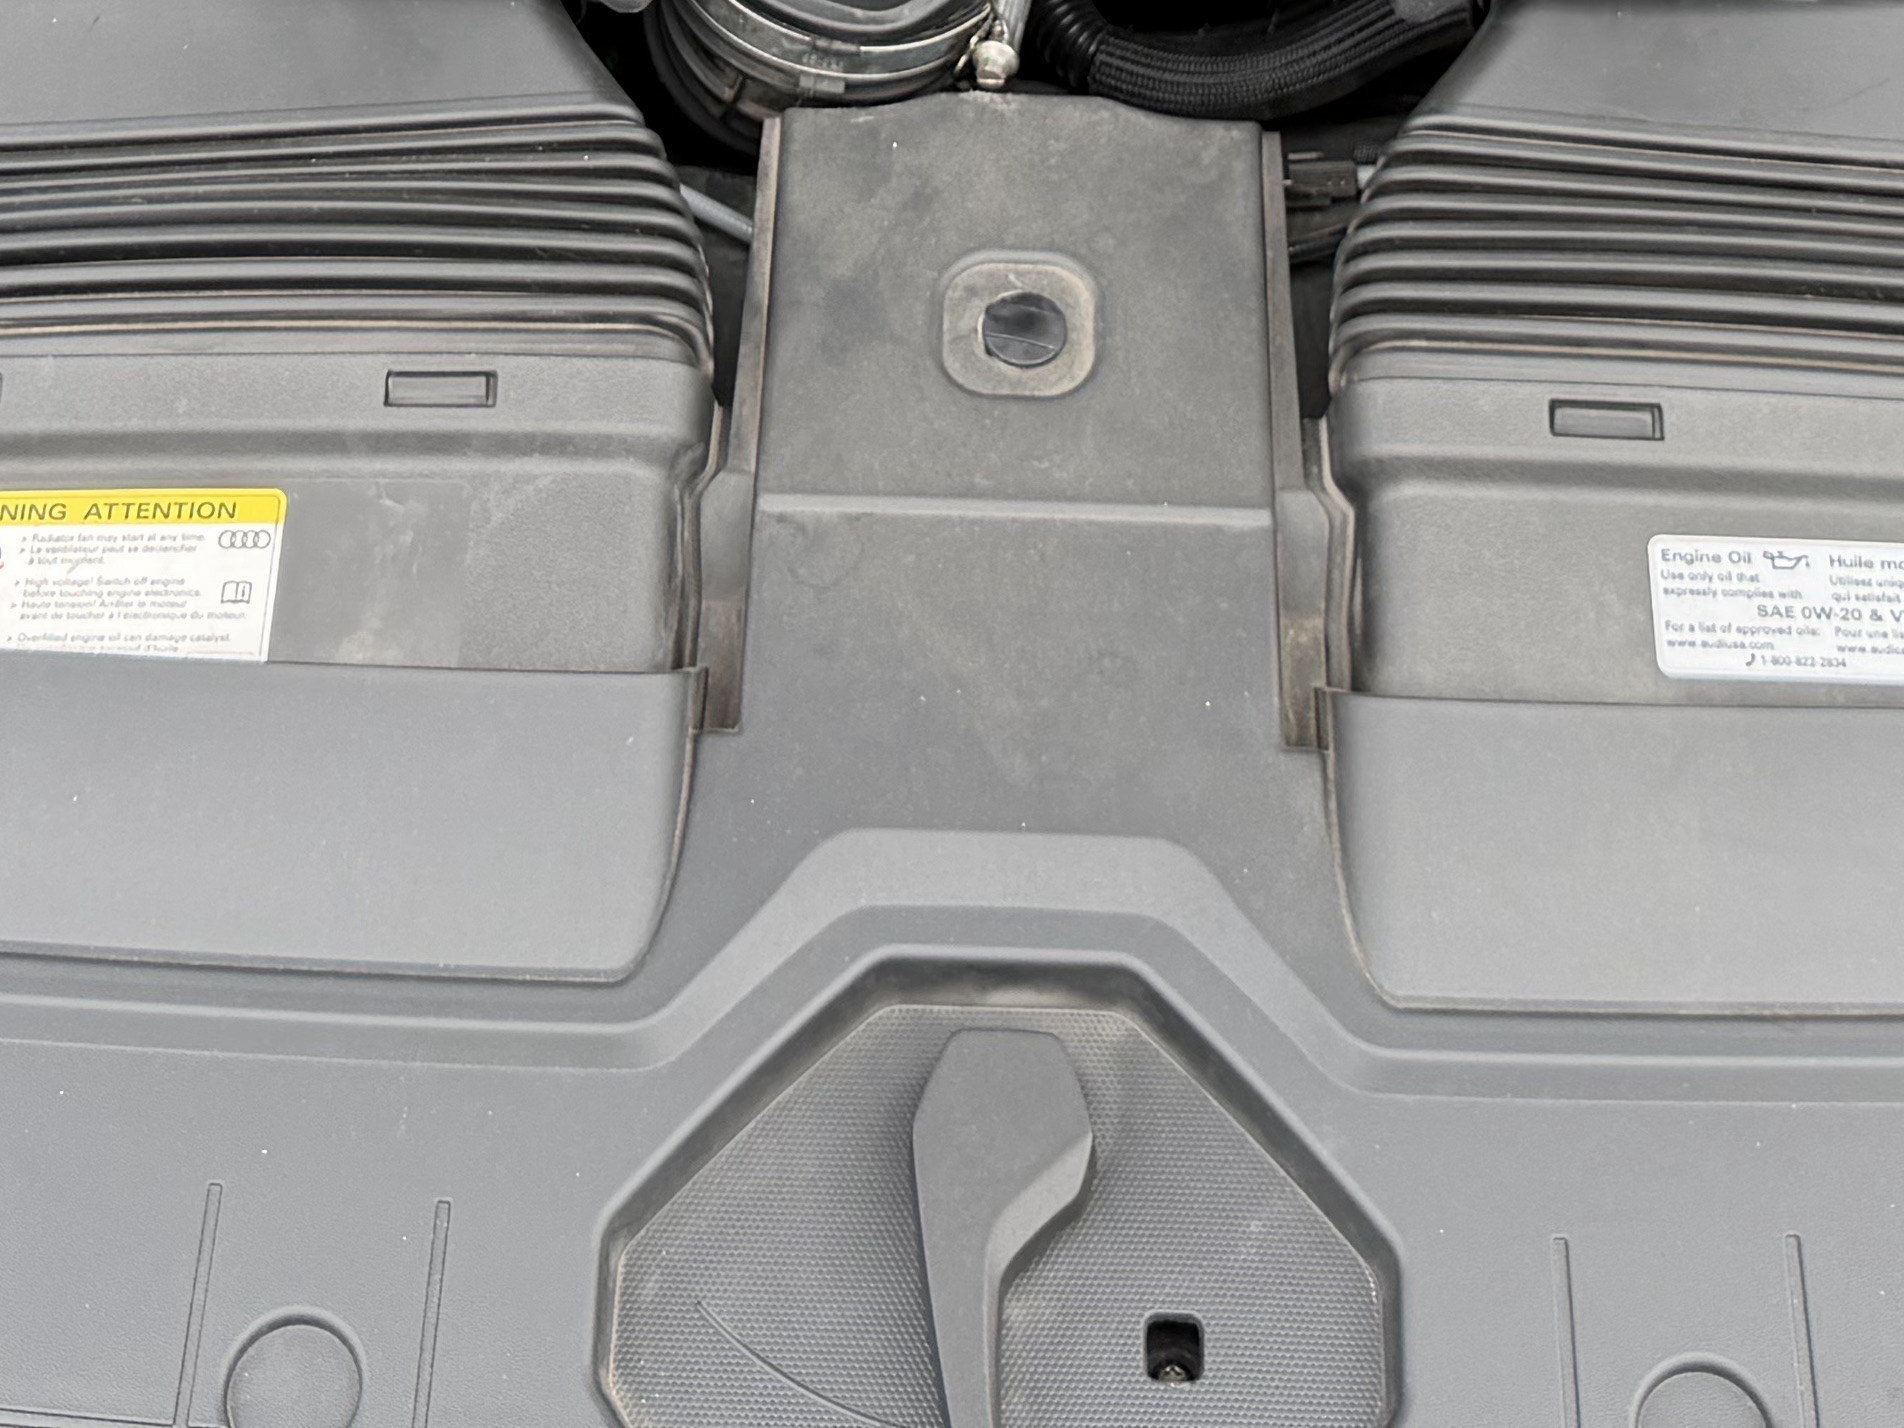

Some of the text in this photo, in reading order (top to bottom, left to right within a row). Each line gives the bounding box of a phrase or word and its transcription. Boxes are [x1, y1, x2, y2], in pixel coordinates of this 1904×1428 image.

[84, 502, 237, 521] ATTENTION
[1661, 548, 1752, 565] Engine Oil
[1829, 554, 1874, 569] Huile
[1661, 569, 1760, 583] Use only oil that
[1778, 589, 1802, 599] with
[1757, 604, 1795, 619] SAE
[1801, 606, 1862, 621] 0W-20
[1870, 609, 1883, 622] &
[1665, 619, 1684, 631] For
[1688, 623, 1695, 632] a
[1698, 621, 1716, 633] list
[1720, 622, 1732, 633] of
[1736, 625, 1792, 636] approved
[1834, 626, 1862, 639] Pour
[1866, 630, 1888, 639] une
